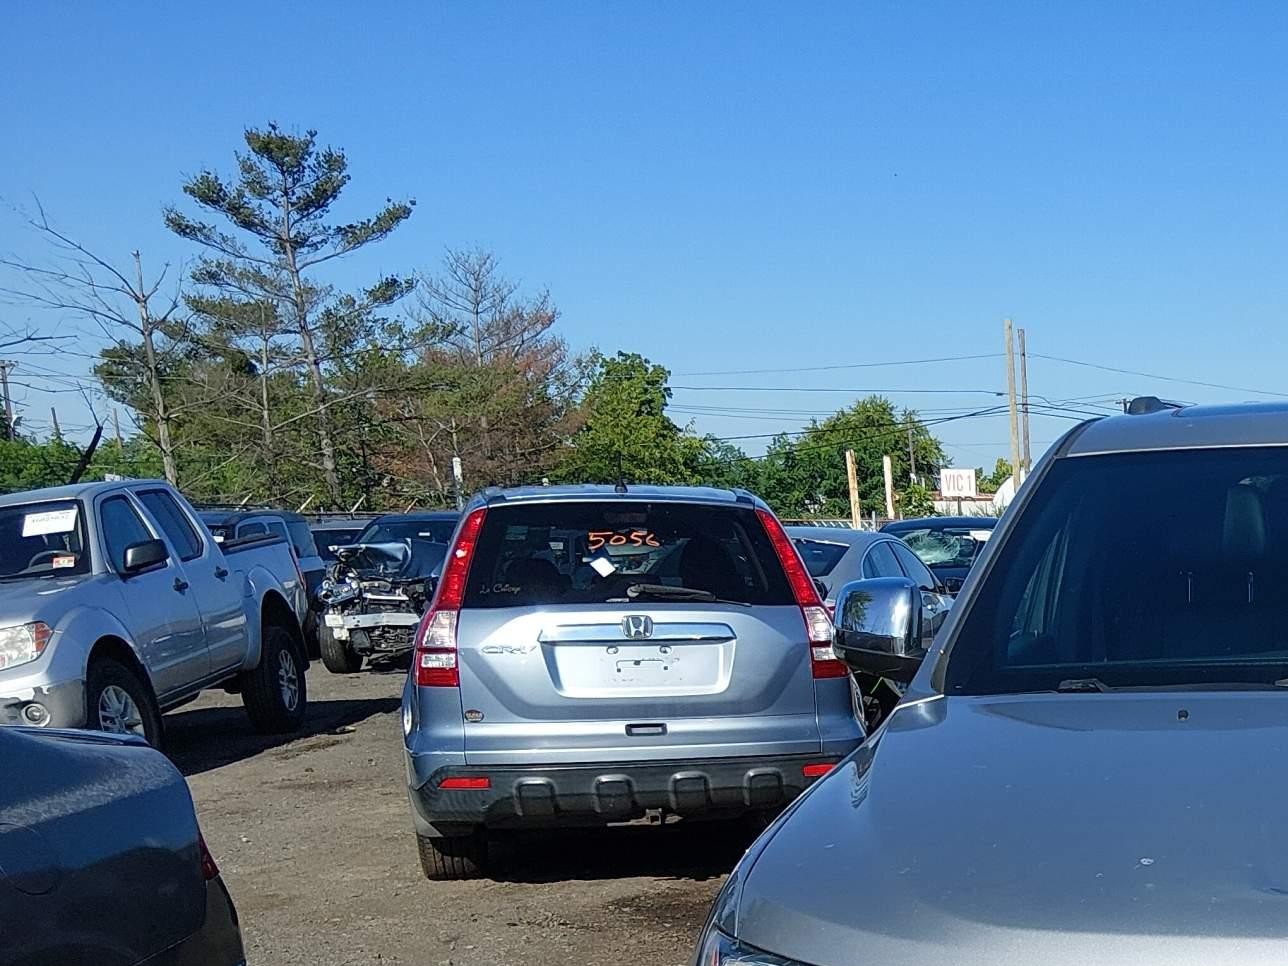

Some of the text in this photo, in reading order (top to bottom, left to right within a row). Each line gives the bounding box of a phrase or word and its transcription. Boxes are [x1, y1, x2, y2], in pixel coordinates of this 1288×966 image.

[945, 473, 972, 492] VIC 1
[588, 531, 660, 550] 5056
